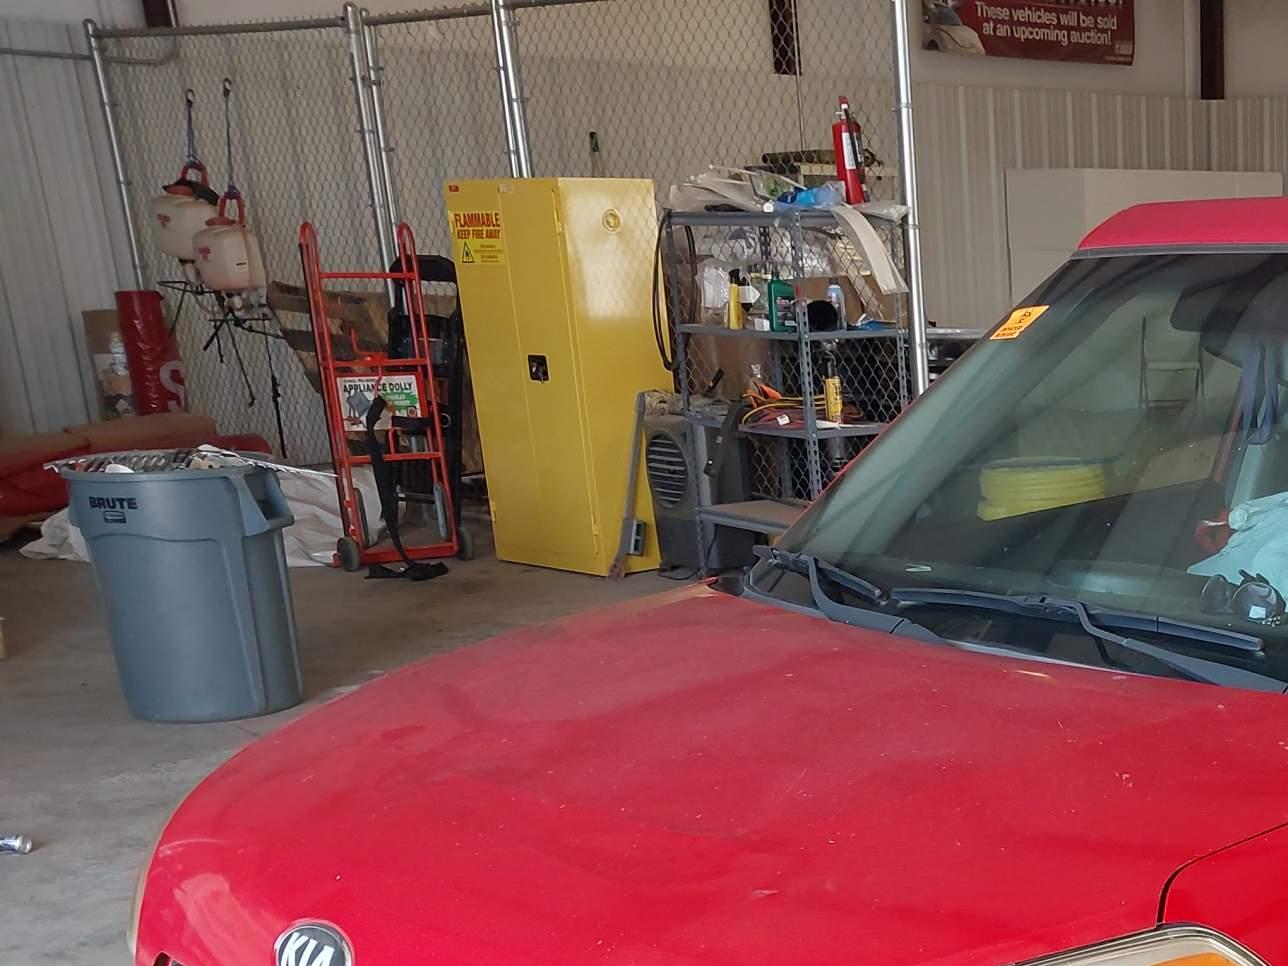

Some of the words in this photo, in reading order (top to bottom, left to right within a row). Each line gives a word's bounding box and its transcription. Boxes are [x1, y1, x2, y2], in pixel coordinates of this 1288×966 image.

[975, 1, 1010, 19] These
[1012, 6, 1058, 25] vehicles
[1060, 11, 1078, 27] will
[1080, 13, 1095, 28] be
[1097, 15, 1117, 30] sold
[982, 20, 994, 35] at
[996, 24, 1013, 36] an
[1013, 26, 1069, 46] upcoming
[1071, 28, 1112, 45] auction!
[454, 212, 501, 228] FLAMMABLE
[457, 229, 471, 240] KEEP
[472, 229, 485, 240] FIRE
[485, 229, 501, 240] AWAY
[388, 381, 413, 392] DOLLY
[89, 496, 138, 510] BRUTE
